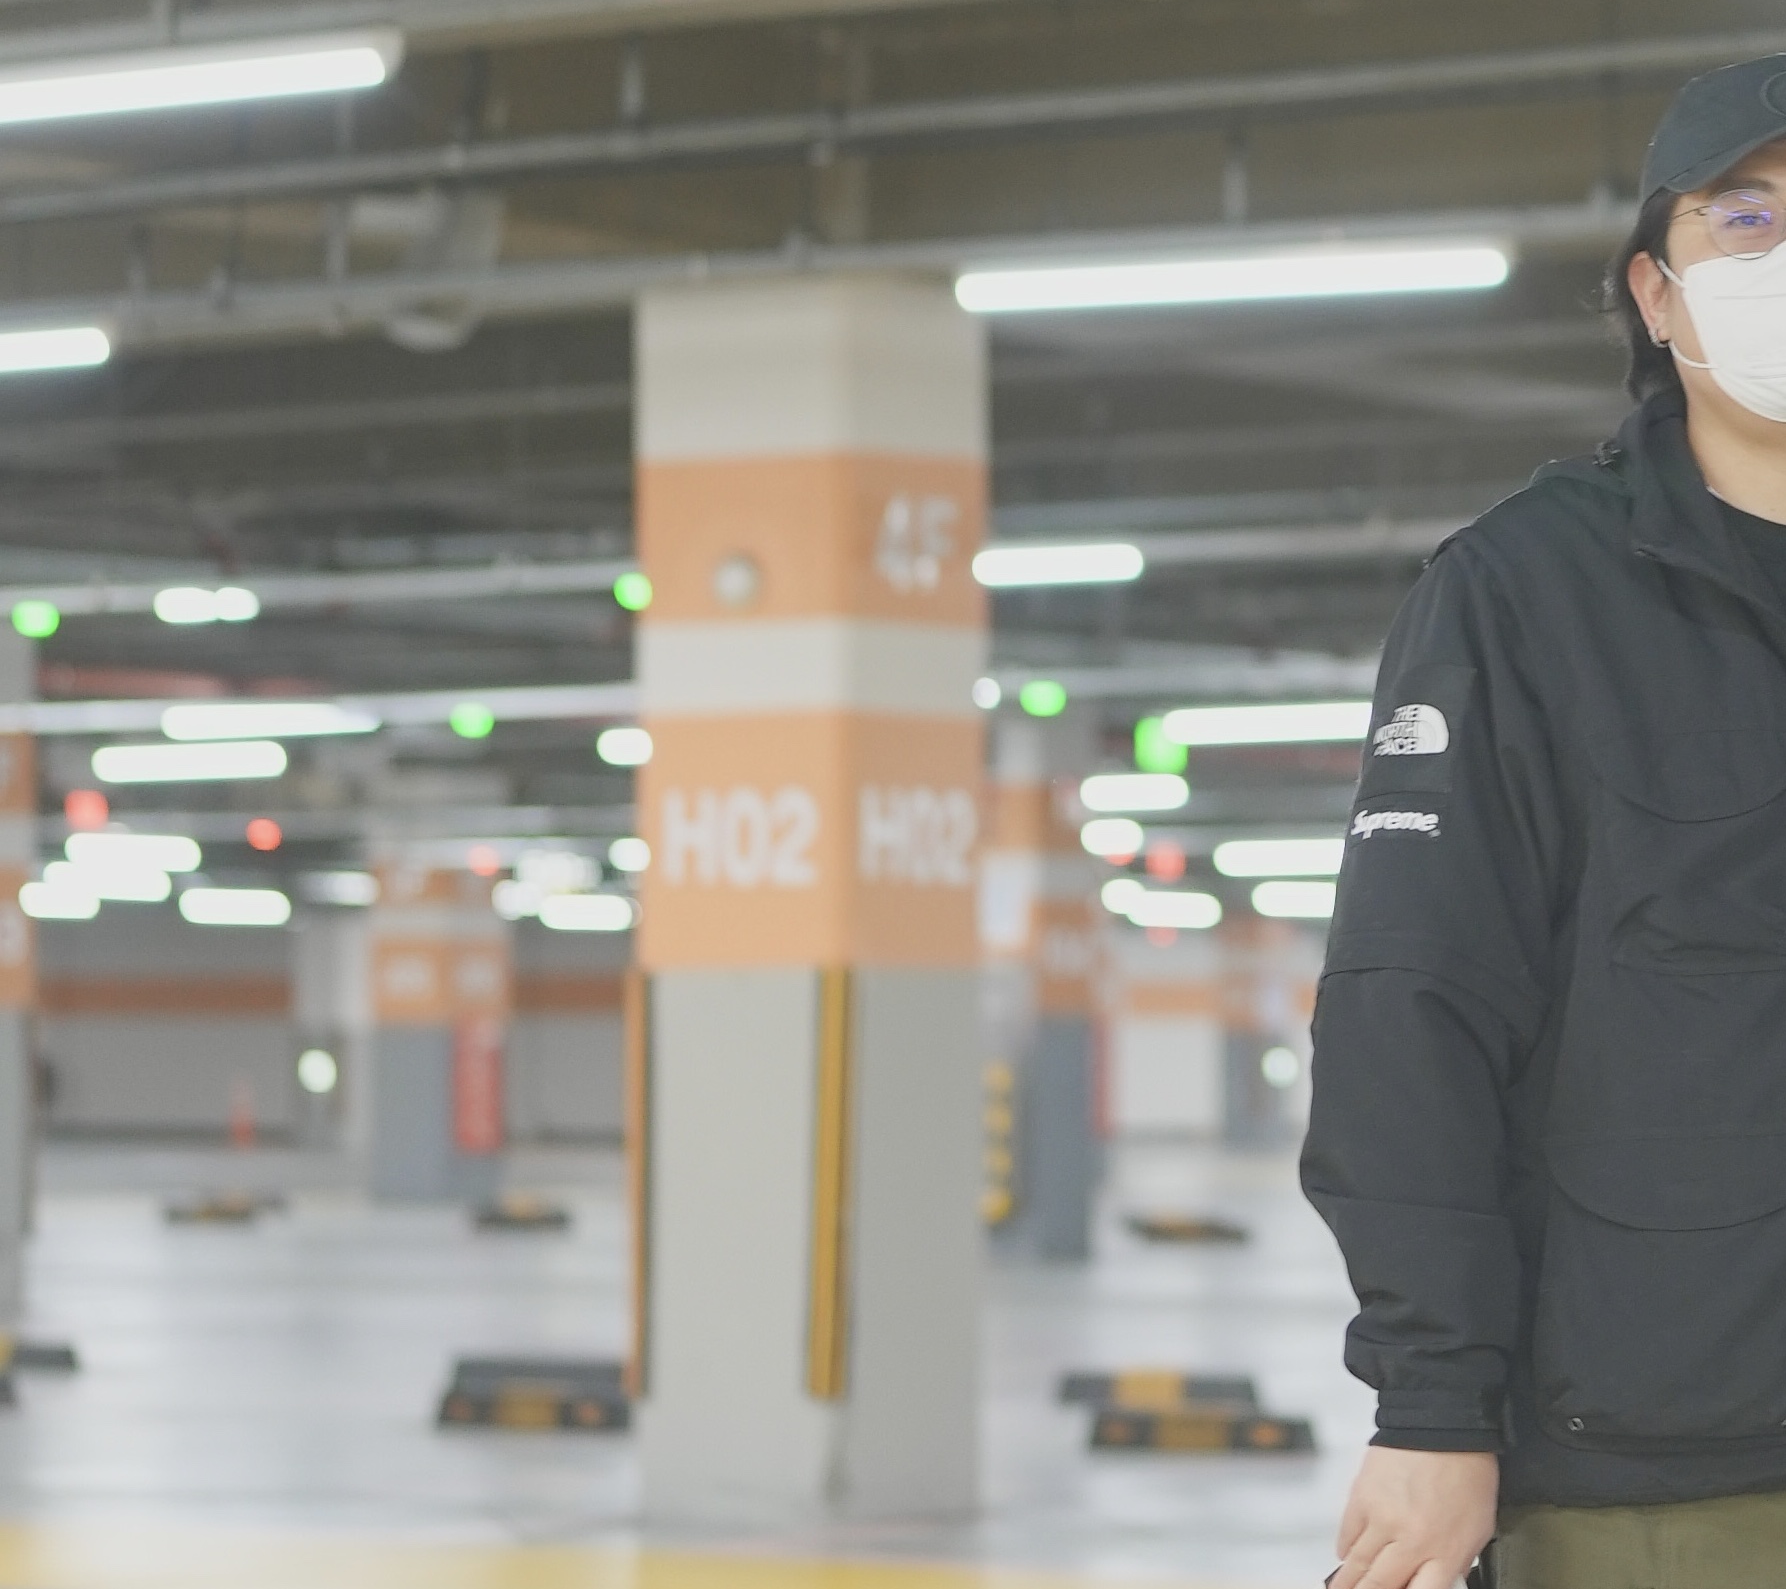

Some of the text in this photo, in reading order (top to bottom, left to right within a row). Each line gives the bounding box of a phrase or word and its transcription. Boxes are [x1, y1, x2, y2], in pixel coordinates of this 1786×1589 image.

[661, 782, 820, 889] H02
[856, 782, 979, 888] H02
[1350, 809, 1440, 840] Supreme
